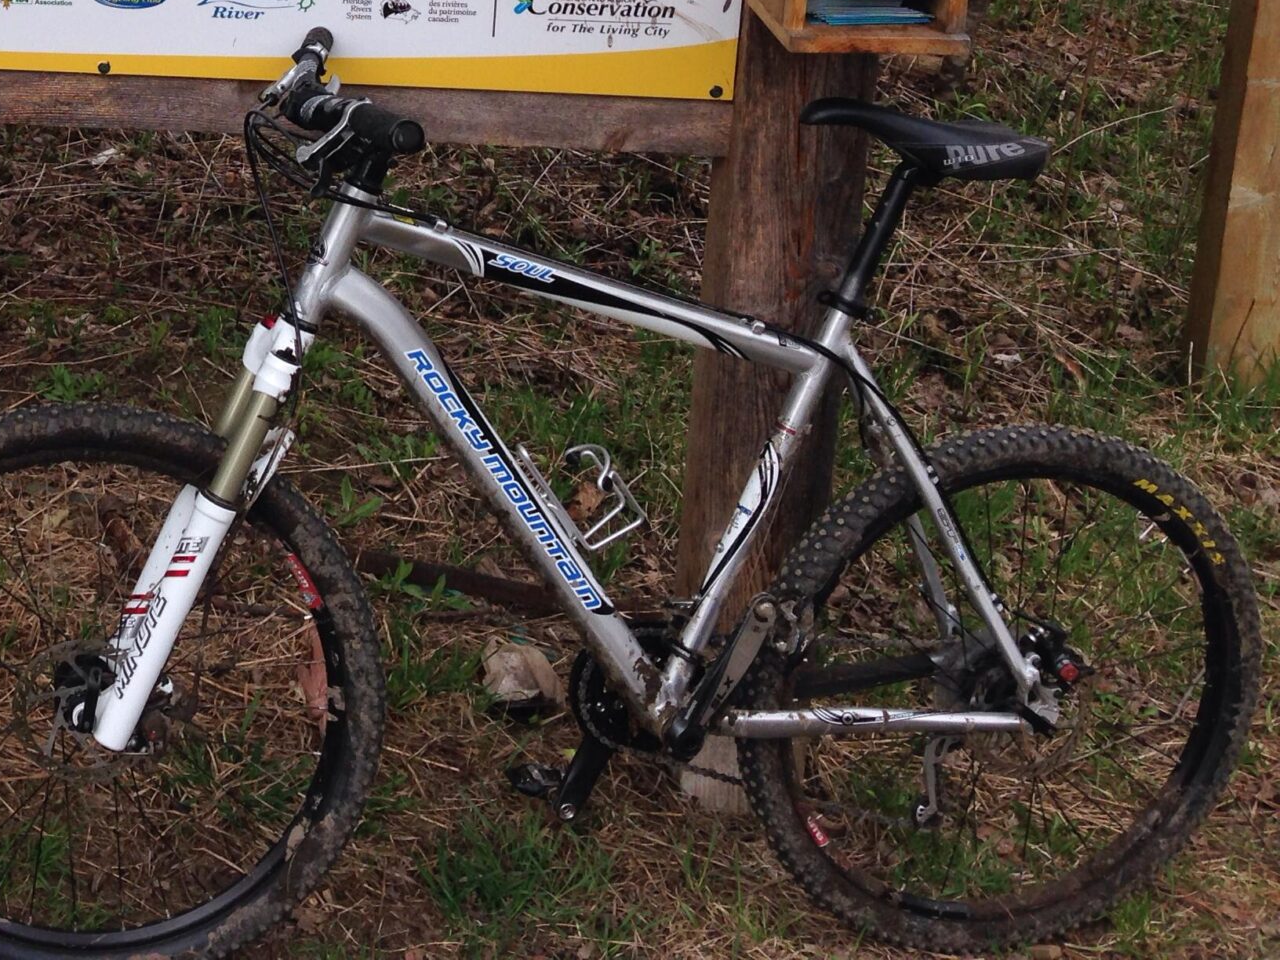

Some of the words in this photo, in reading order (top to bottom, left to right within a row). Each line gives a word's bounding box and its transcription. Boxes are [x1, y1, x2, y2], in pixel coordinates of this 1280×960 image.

[212, 6, 265, 20] River
[546, 22, 566, 32] for
[572, 24, 595, 34] The
[600, 25, 640, 38] Living
[644, 26, 670, 38] City
[946, 143, 1025, 170] pure
[488, 254, 556, 284] SOUL
[404, 348, 491, 454] ROCKY
